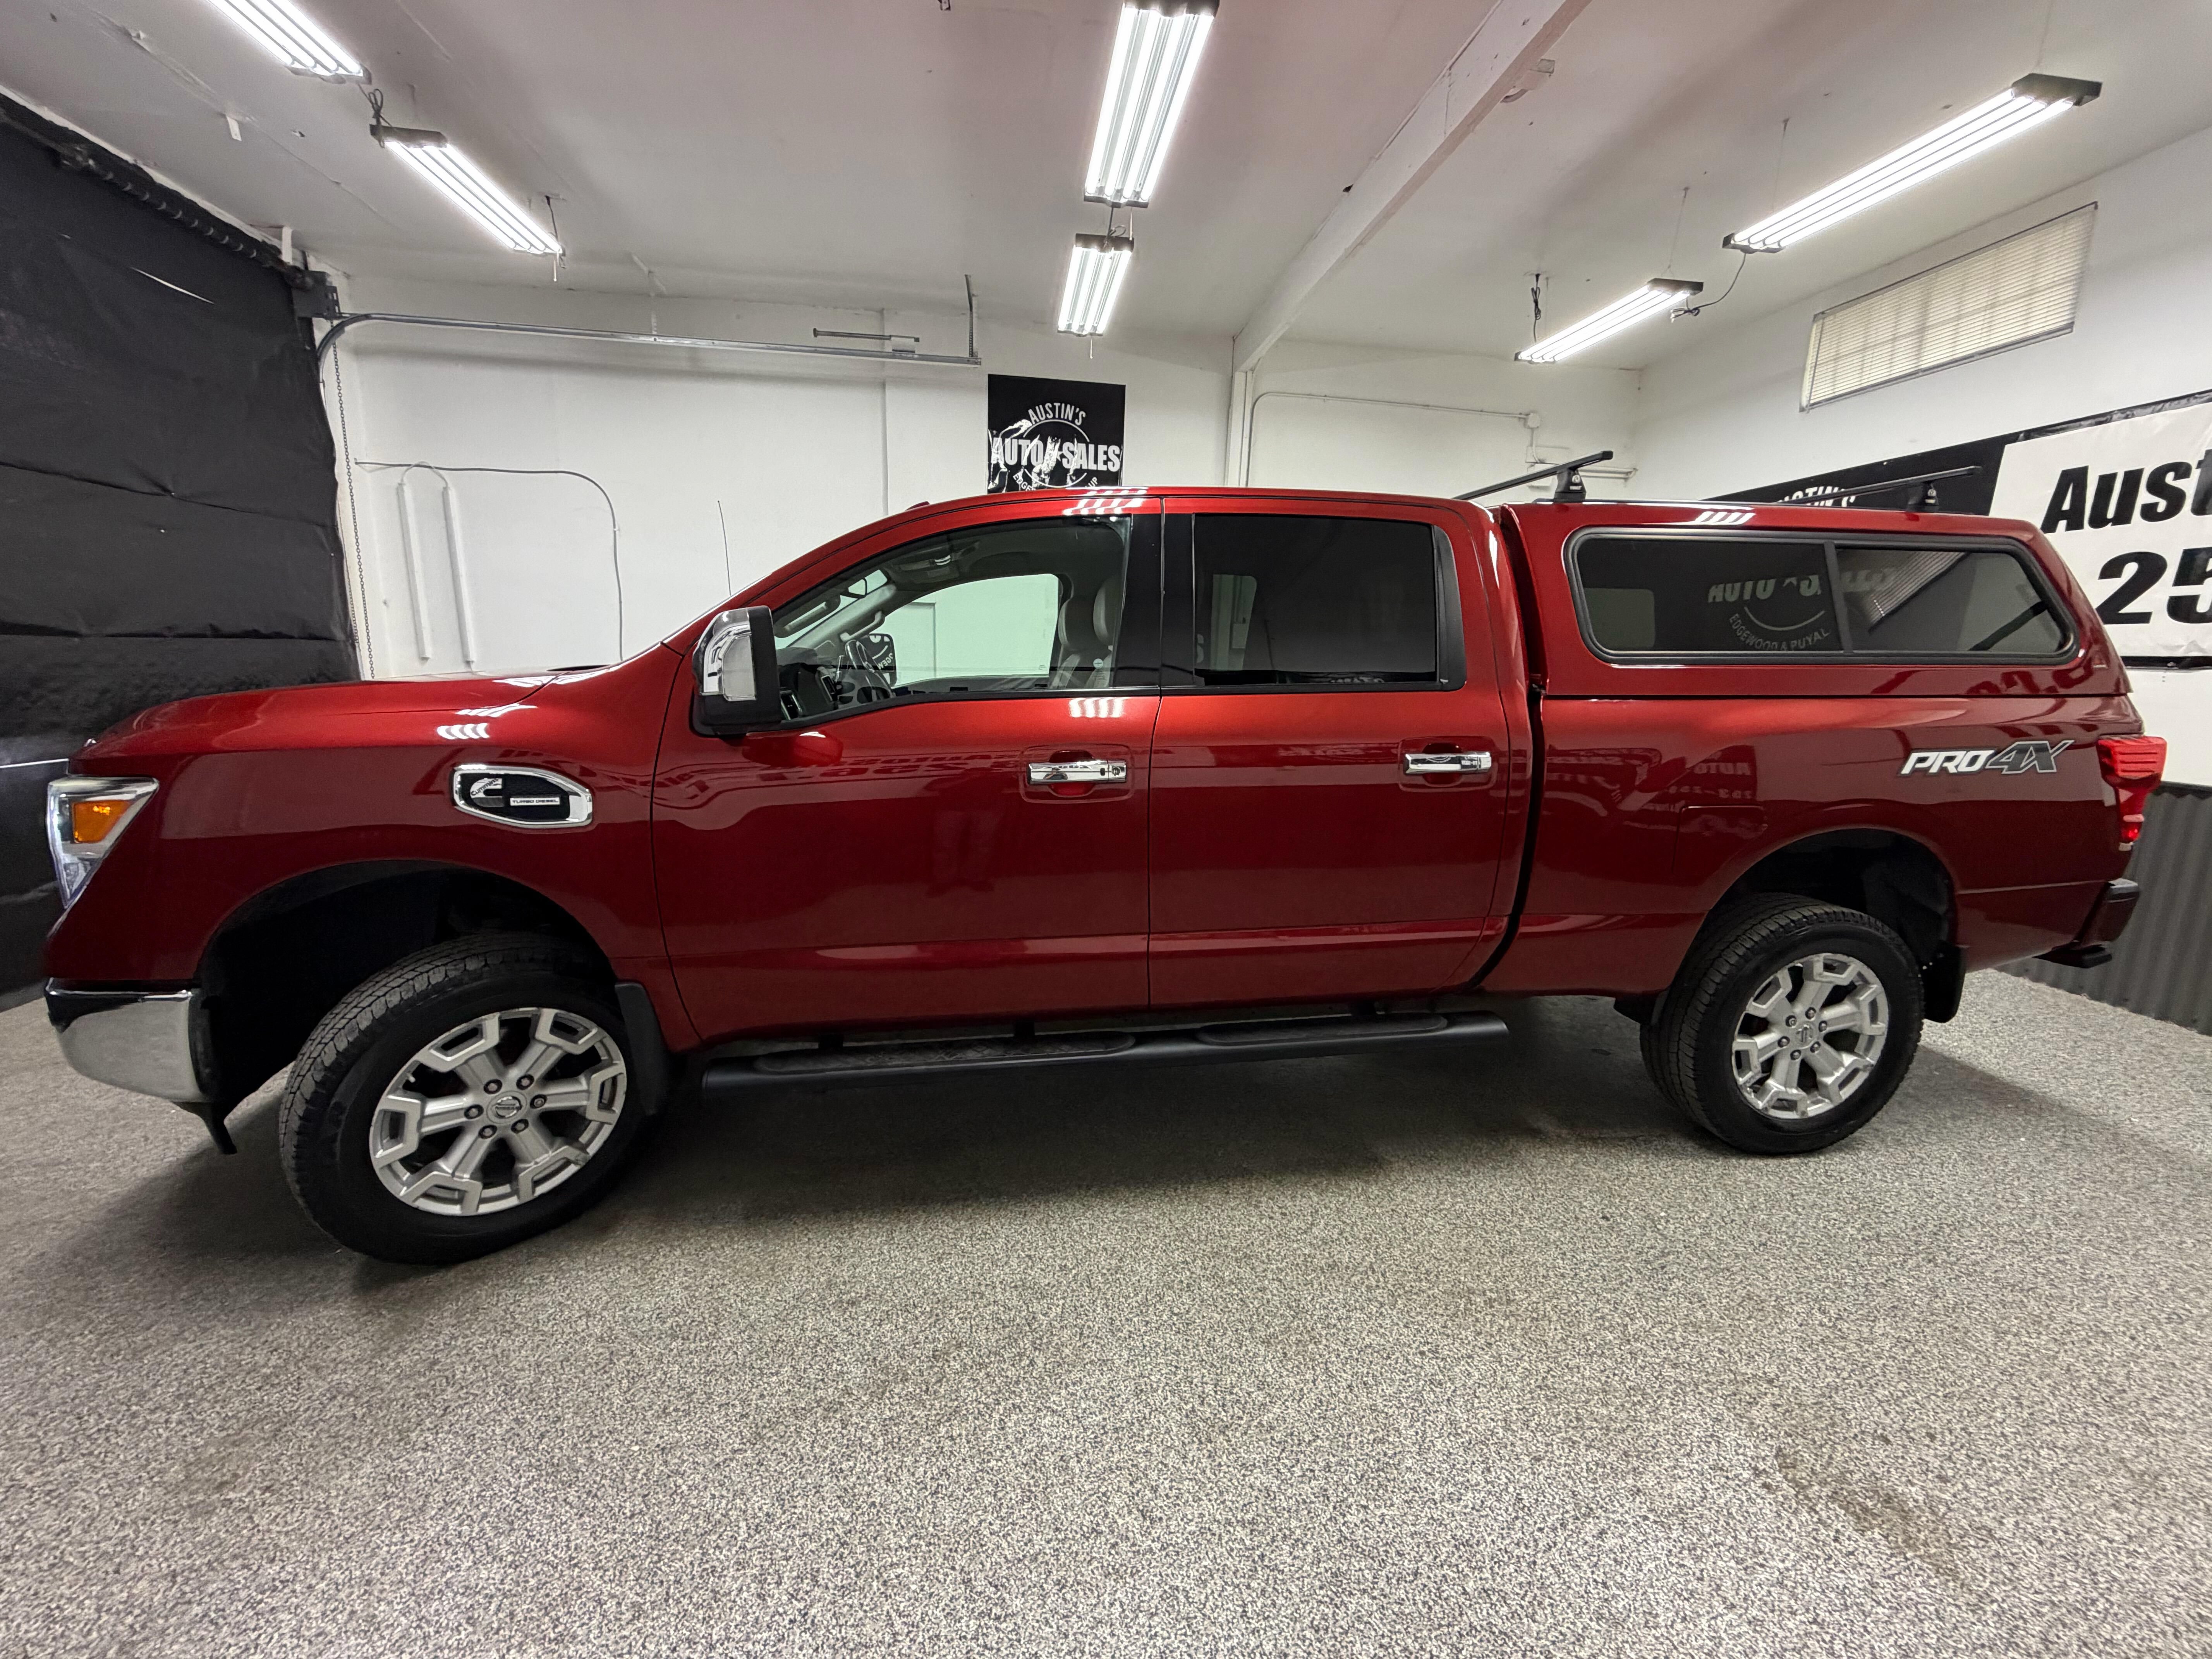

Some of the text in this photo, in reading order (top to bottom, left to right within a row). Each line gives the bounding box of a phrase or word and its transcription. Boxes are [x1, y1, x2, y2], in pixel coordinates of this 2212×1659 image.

[1028, 402, 1086, 426] AUSTIN'S
[991, 437, 1120, 472] AUTO SALES
[2040, 448, 2212, 533] Aust
[471, 778, 499, 796] Cummins
